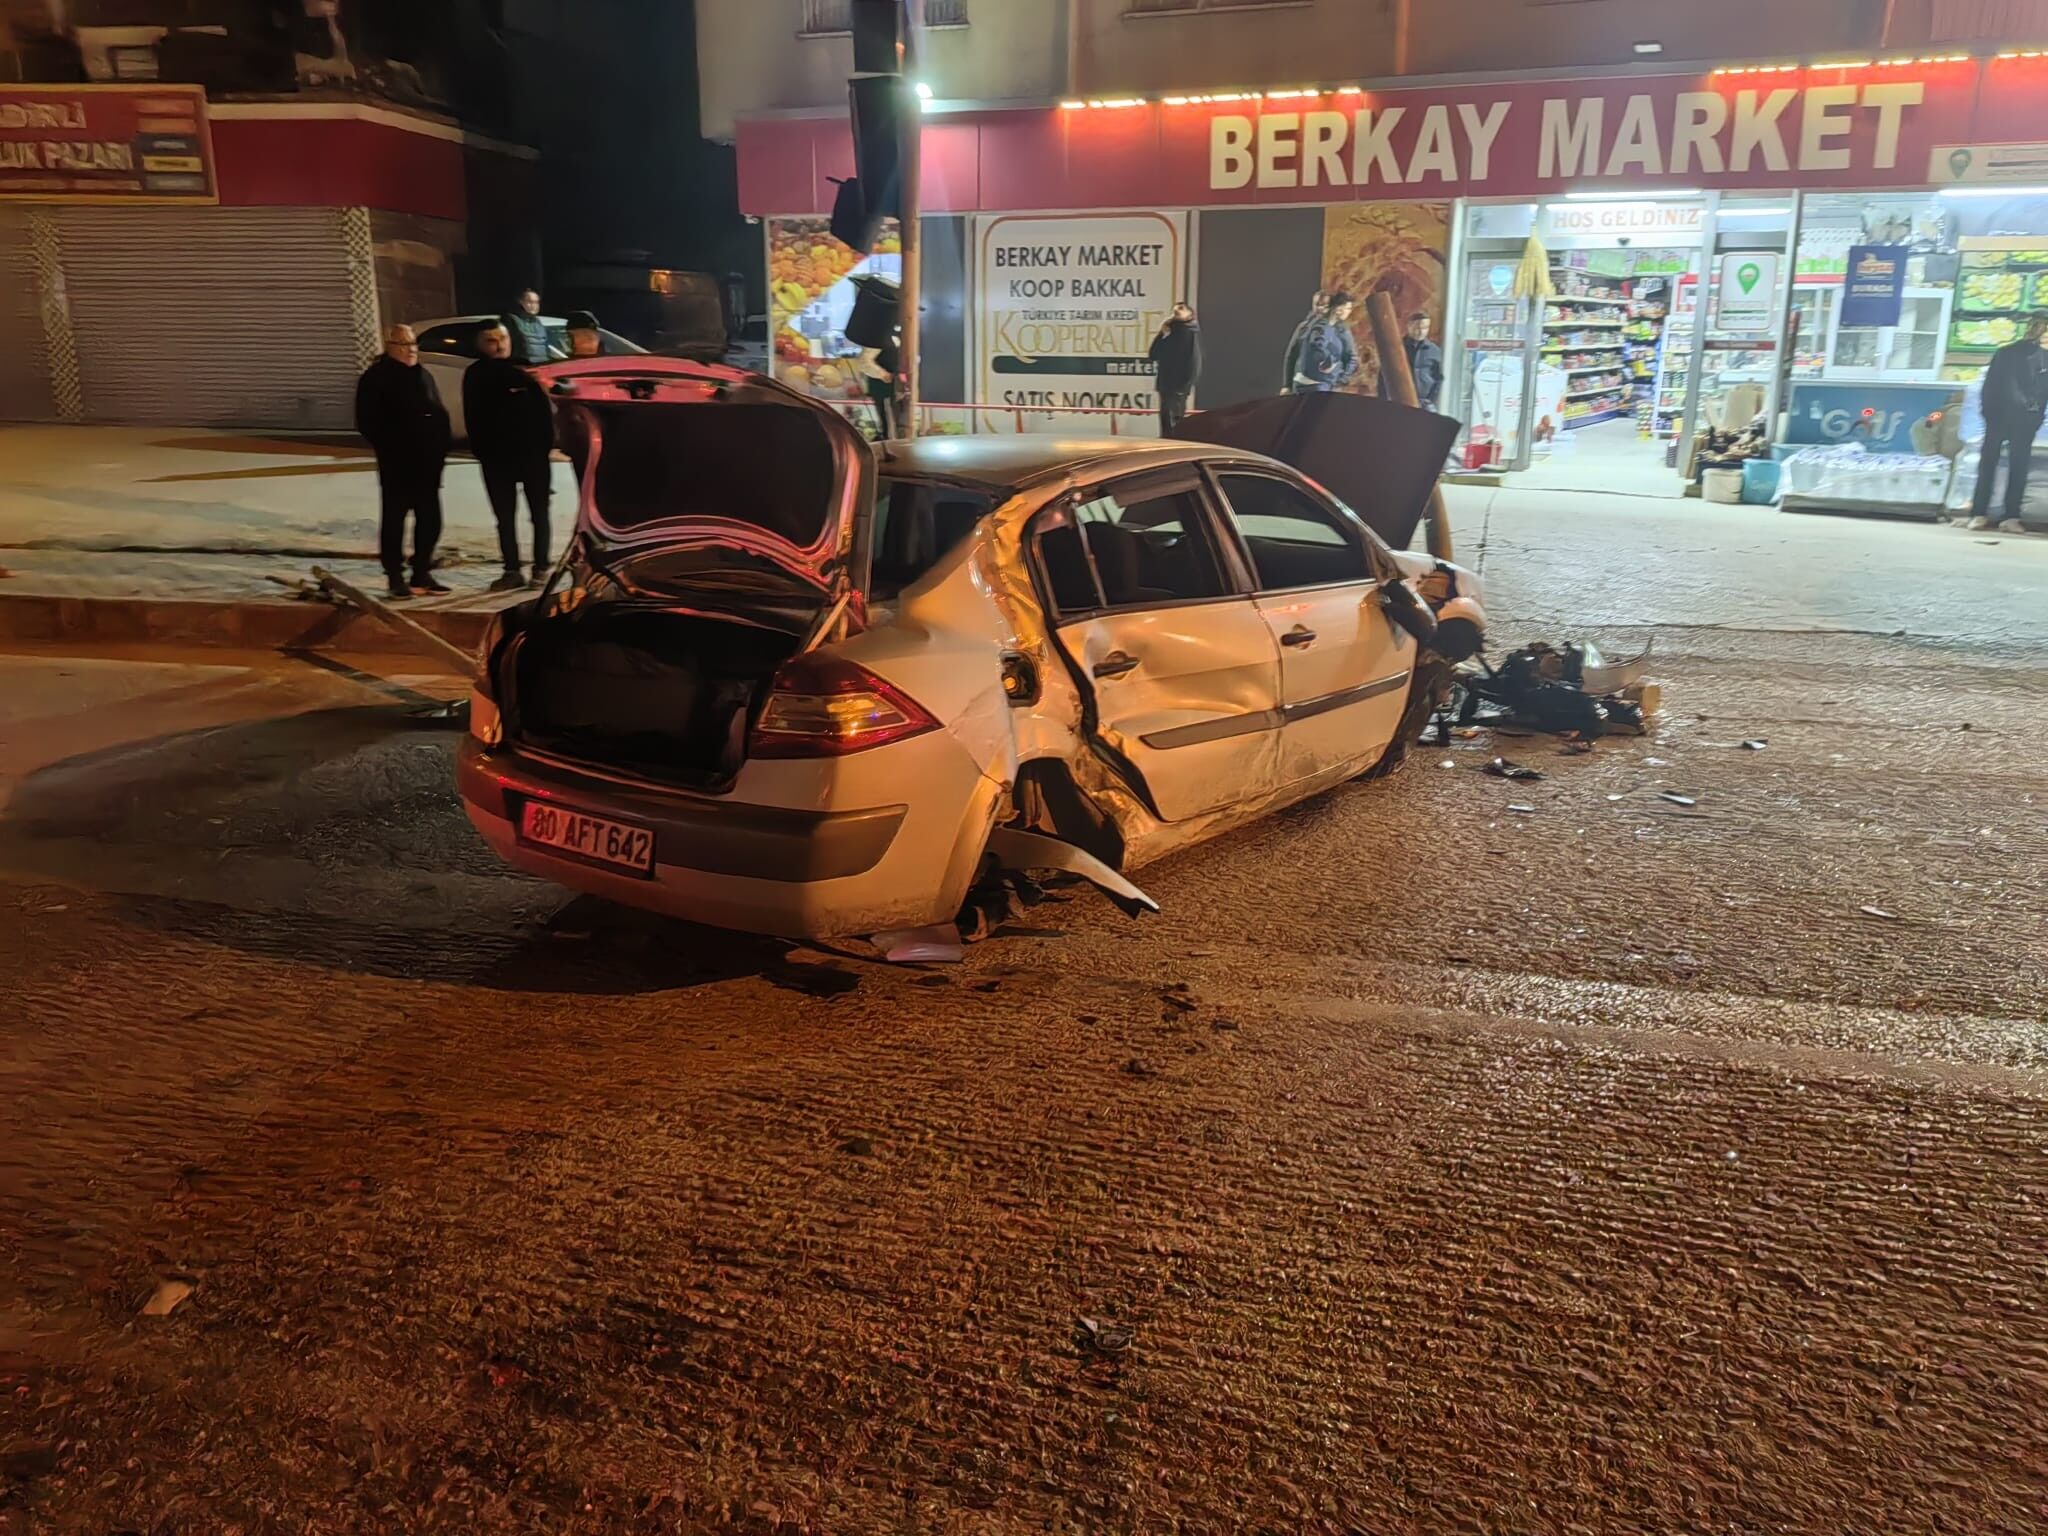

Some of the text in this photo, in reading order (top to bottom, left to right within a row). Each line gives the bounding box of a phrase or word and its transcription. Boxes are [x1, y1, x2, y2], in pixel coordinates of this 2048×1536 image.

[1210, 82, 1925, 190] BERKAY MARKET
[995, 244, 1163, 267] BERKAY MARKET
[1010, 278, 1146, 298] KOOP BAKKAL
[1003, 390, 1153, 420] SATIŞ NOKTASI
[533, 806, 650, 865] 80 AFT 642
